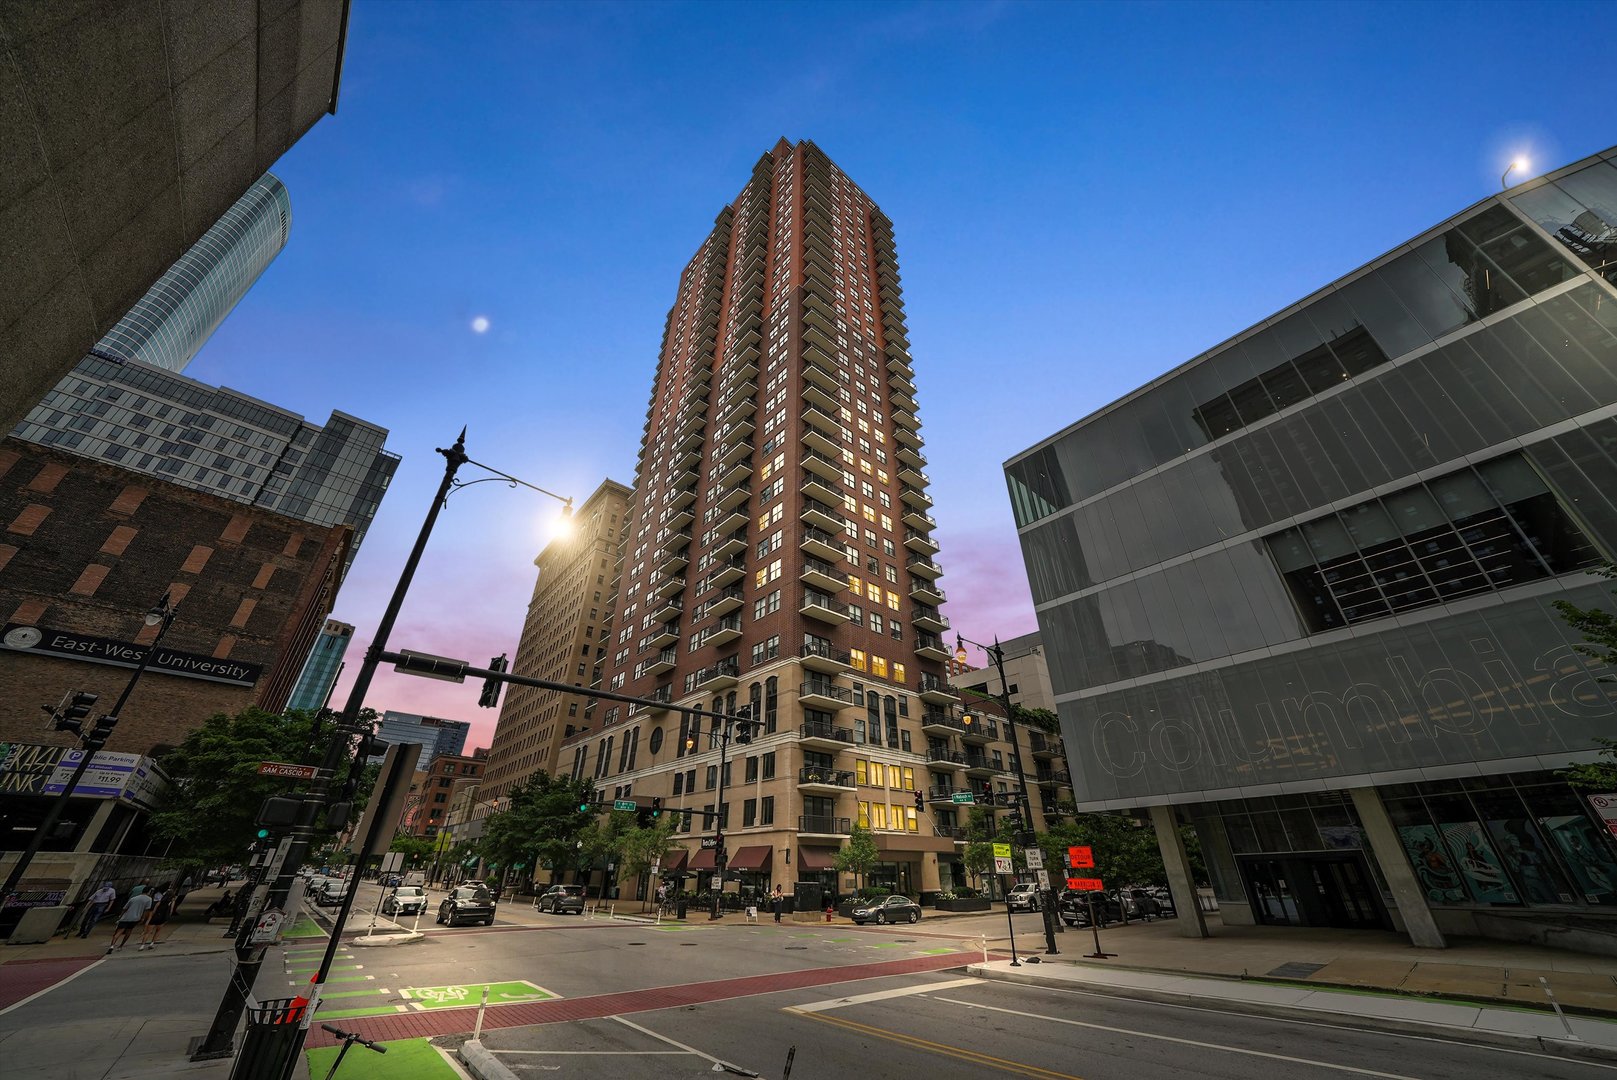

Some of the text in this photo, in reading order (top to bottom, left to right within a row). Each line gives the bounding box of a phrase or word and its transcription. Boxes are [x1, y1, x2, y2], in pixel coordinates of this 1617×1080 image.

[50, 634, 250, 680] East-Wes University
[108, 755, 135, 764] Parking
[261, 766, 278, 774] SAM
[279, 768, 303, 777] CASCIO
[98, 775, 121, 784] $11.99
